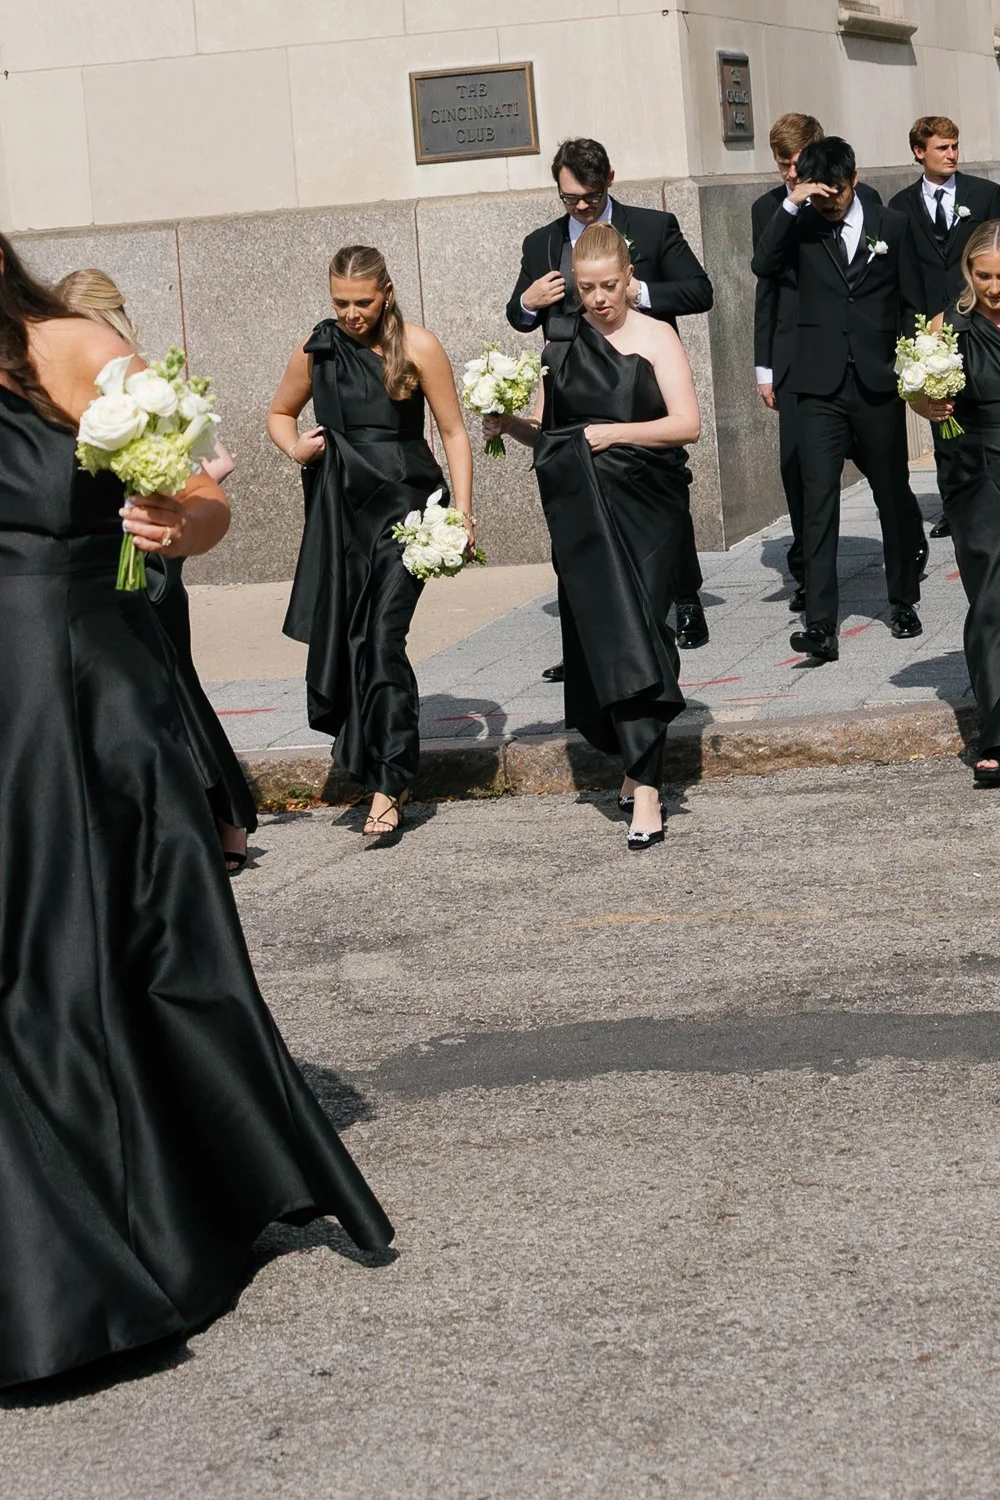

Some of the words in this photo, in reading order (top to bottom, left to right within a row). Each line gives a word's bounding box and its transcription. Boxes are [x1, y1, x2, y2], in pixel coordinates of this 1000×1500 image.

[456, 83, 488, 99] THE
[431, 103, 519, 124] CINCINNATI
[456, 127, 495, 144] CLUB
